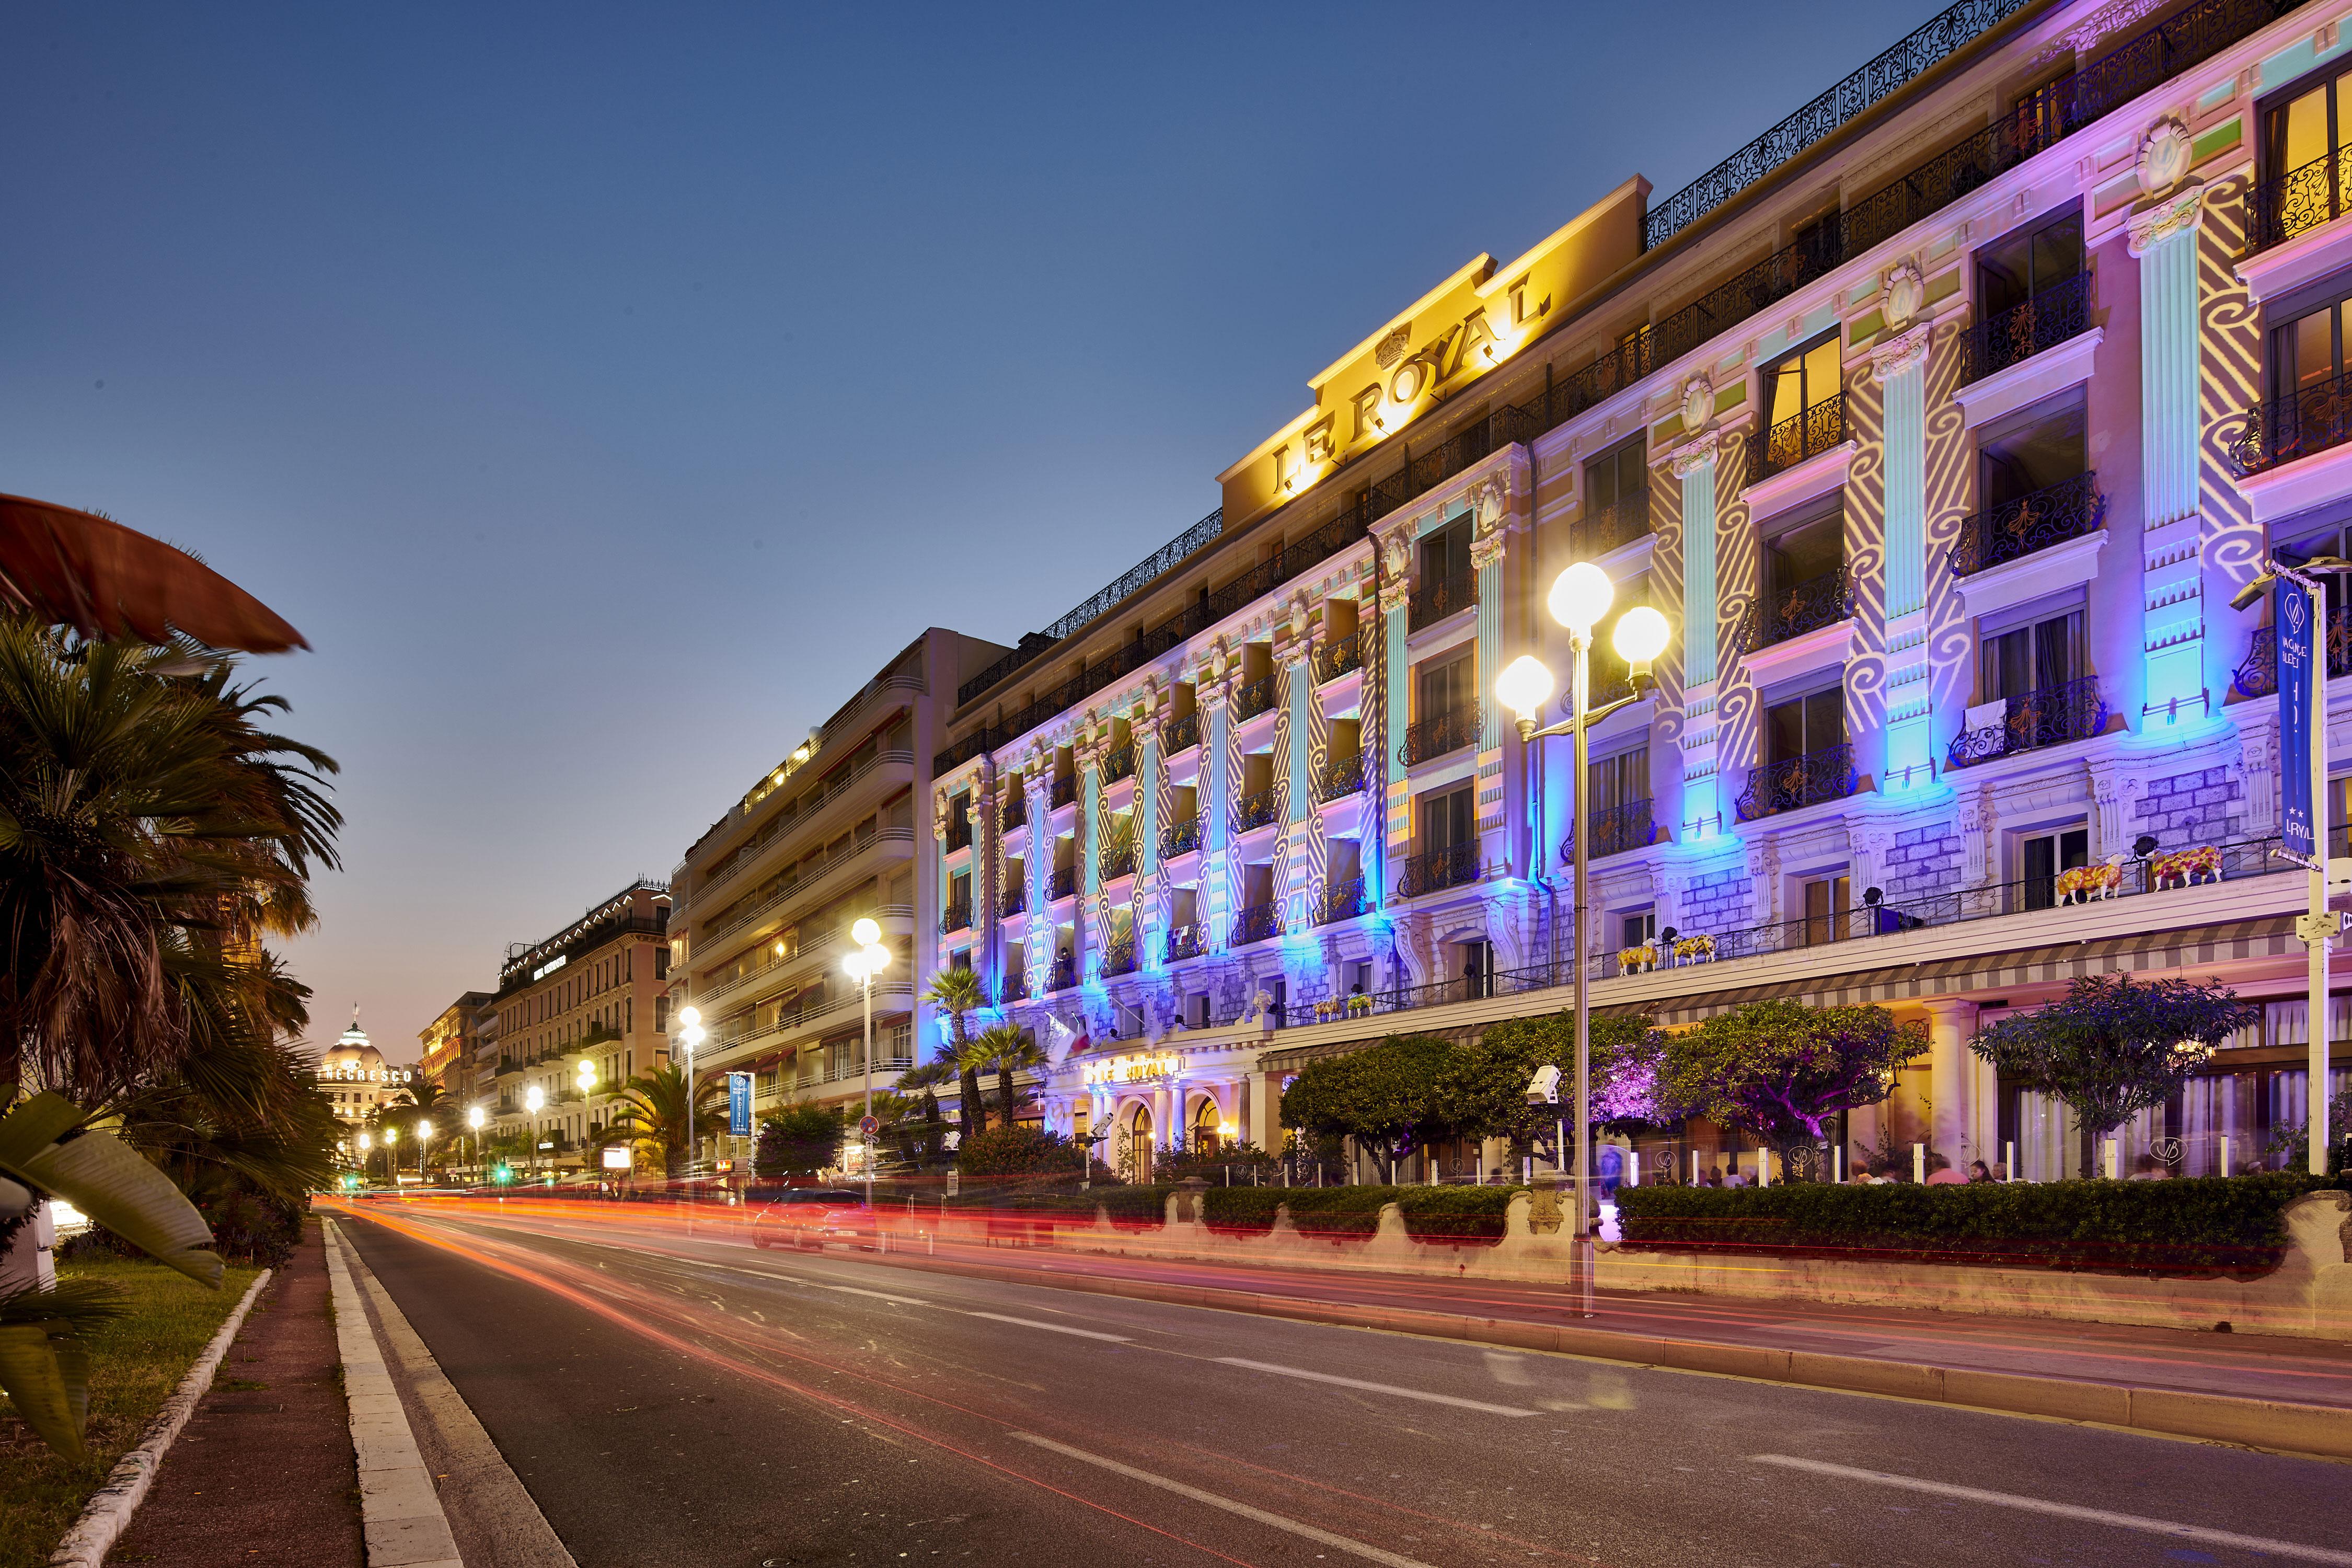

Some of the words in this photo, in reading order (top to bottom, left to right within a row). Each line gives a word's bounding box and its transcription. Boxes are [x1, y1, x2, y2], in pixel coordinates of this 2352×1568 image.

[1273, 418, 1331, 494] LE
[1348, 281, 1546, 443] ROYAL
[326, 1069, 412, 1082] NEGRESCO
[1101, 1069, 1114, 1081] LE
[1127, 1062, 1168, 1079] ROYAL
